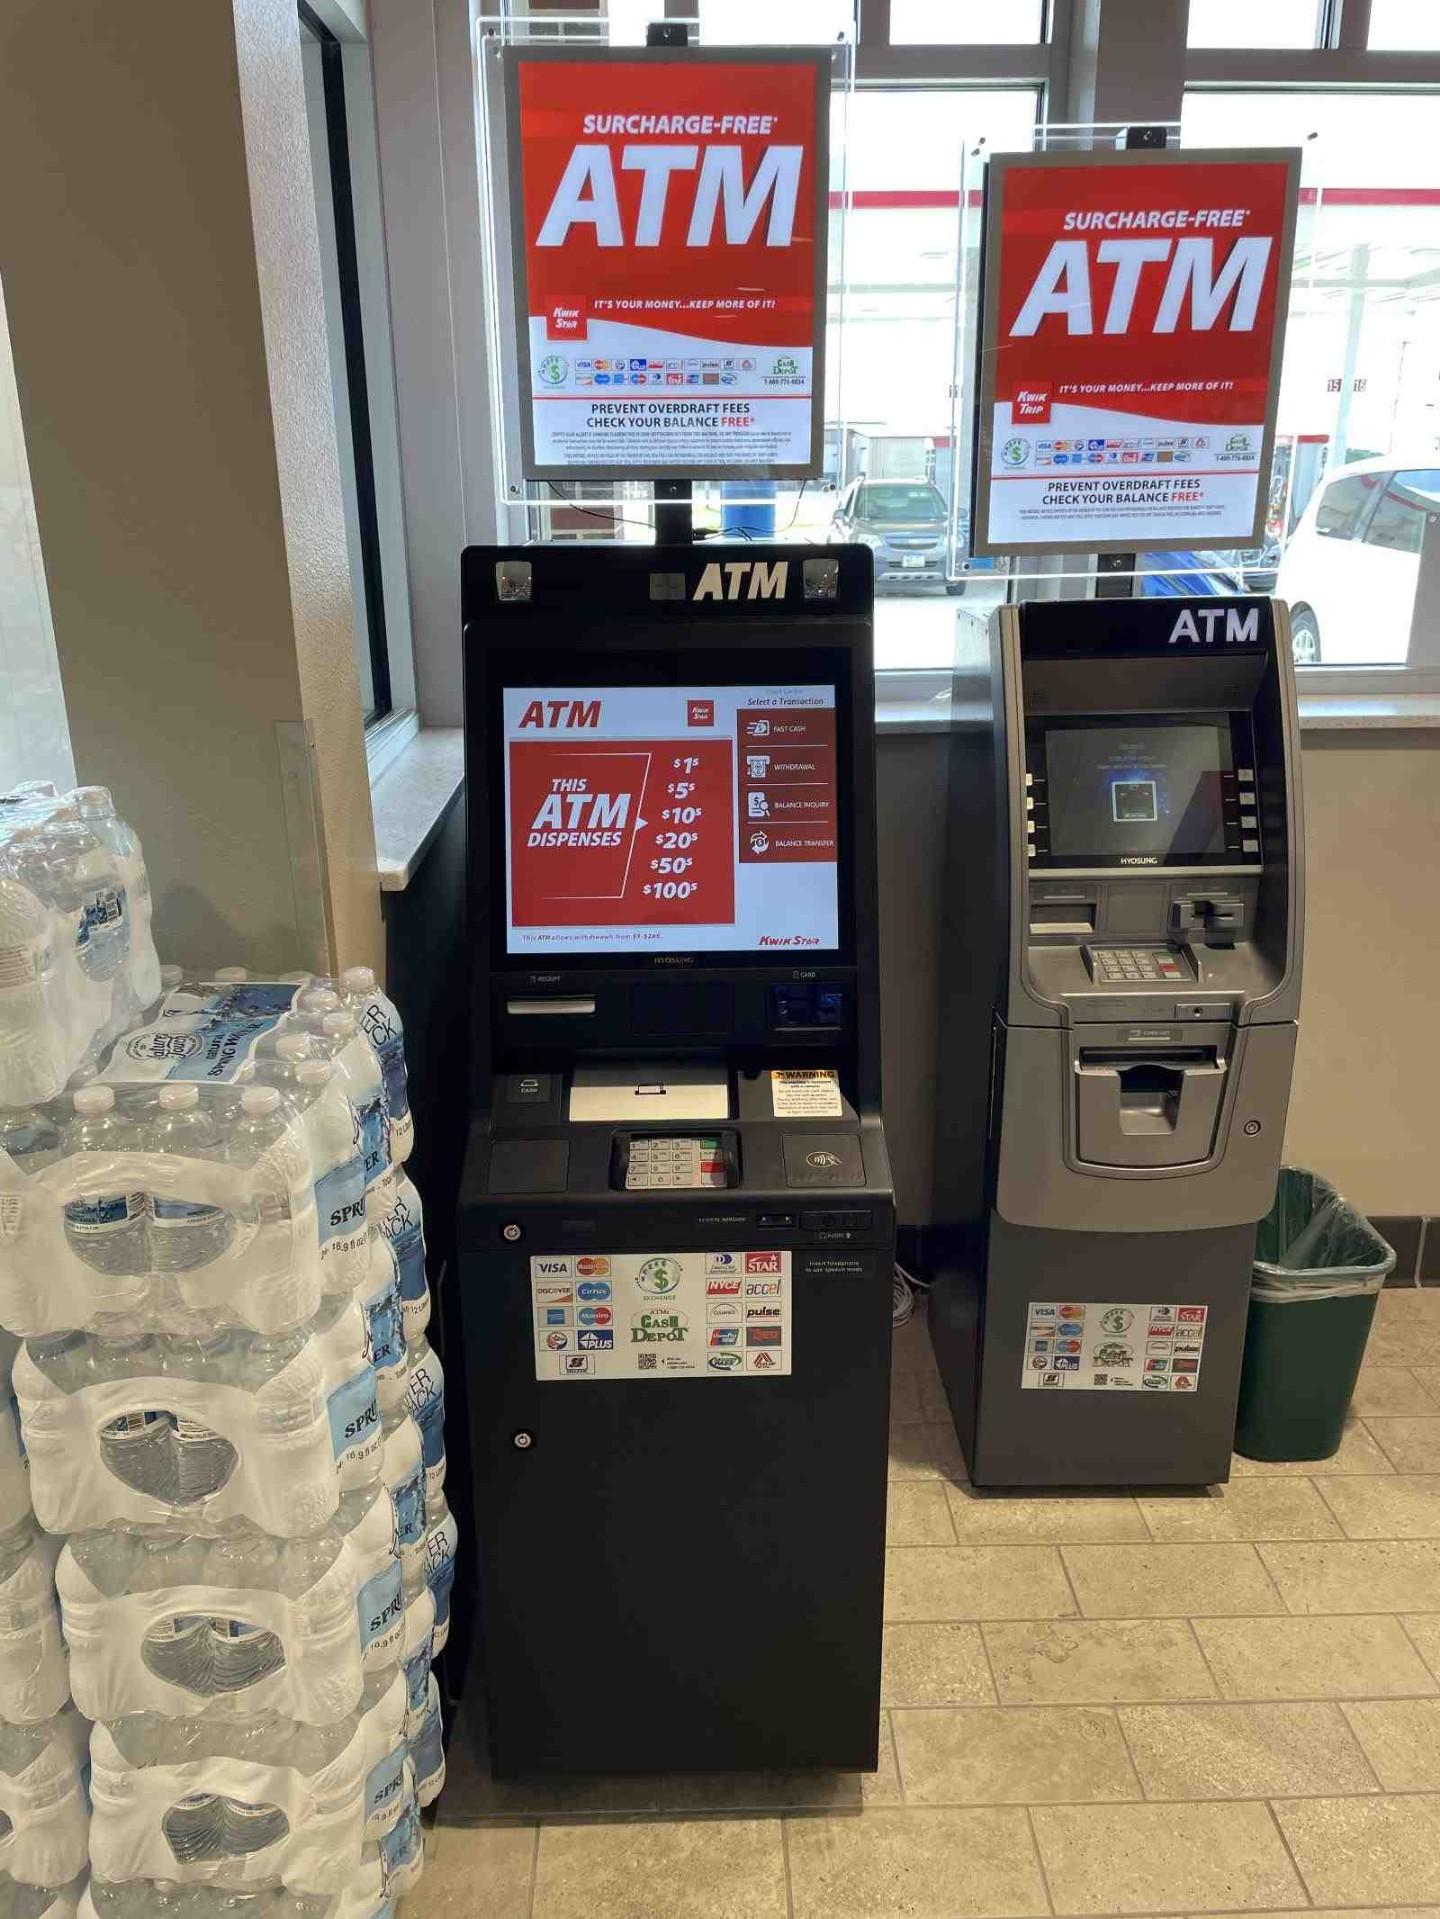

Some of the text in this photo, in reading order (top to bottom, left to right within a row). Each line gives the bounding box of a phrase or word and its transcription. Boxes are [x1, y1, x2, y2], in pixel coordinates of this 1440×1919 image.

[535, 144, 804, 247] ATM
[1008, 236, 1273, 336] ATM
[594, 300, 613, 309] IT'S
[616, 300, 642, 309] YOUR
[715, 300, 745, 308] MORE
[747, 300, 760, 308] OF
[762, 300, 776, 308] IT!
[1060, 384, 1078, 393] IT'S
[1080, 384, 1106, 393] YOUR
[1175, 382, 1203, 391] MORE
[1205, 382, 1218, 390] OF
[1220, 381, 1234, 390] IT!
[592, 403, 750, 414] PREVENT OVERDRAFT FEES
[586, 417, 625, 428] CHECK
[628, 417, 661, 428] YOUR
[663, 417, 718, 428] BALANCE
[1048, 478, 1201, 492] PREVENT OVERDRAFT FEES
[1042, 493, 1080, 505] CHECK
[1081, 493, 1113, 505] YOUR
[1116, 492, 1169, 503] BALANCE
[692, 561, 790, 600] ATM
[1169, 608, 1259, 643] ATM
[747, 697, 770, 706] Select
[779, 696, 824, 706] Transaction
[518, 699, 602, 729] ATM
[774, 763, 816, 771] WITHDRAWAL
[551, 778, 587, 792] THIS
[803, 801, 829, 809] INQUIRY
[531, 793, 632, 830] ATM
[527, 831, 622, 847] DISPENSES
[804, 839, 834, 847] TRANSFER
[1121, 857, 1158, 865] HYOSUNG
[785, 1071, 834, 1079] WARNING
[540, 1263, 568, 1273] VISA
[748, 1261, 778, 1272] STAR
[710, 1280, 740, 1290] NYCE
[746, 1279, 781, 1296] accel
[746, 1306, 781, 1318] pulse
[1036, 1308, 1055, 1316] VISA
[640, 1315, 679, 1328] CASH
[631, 1328, 689, 1343] DEPOT
[588, 1340, 613, 1349] PLUS
